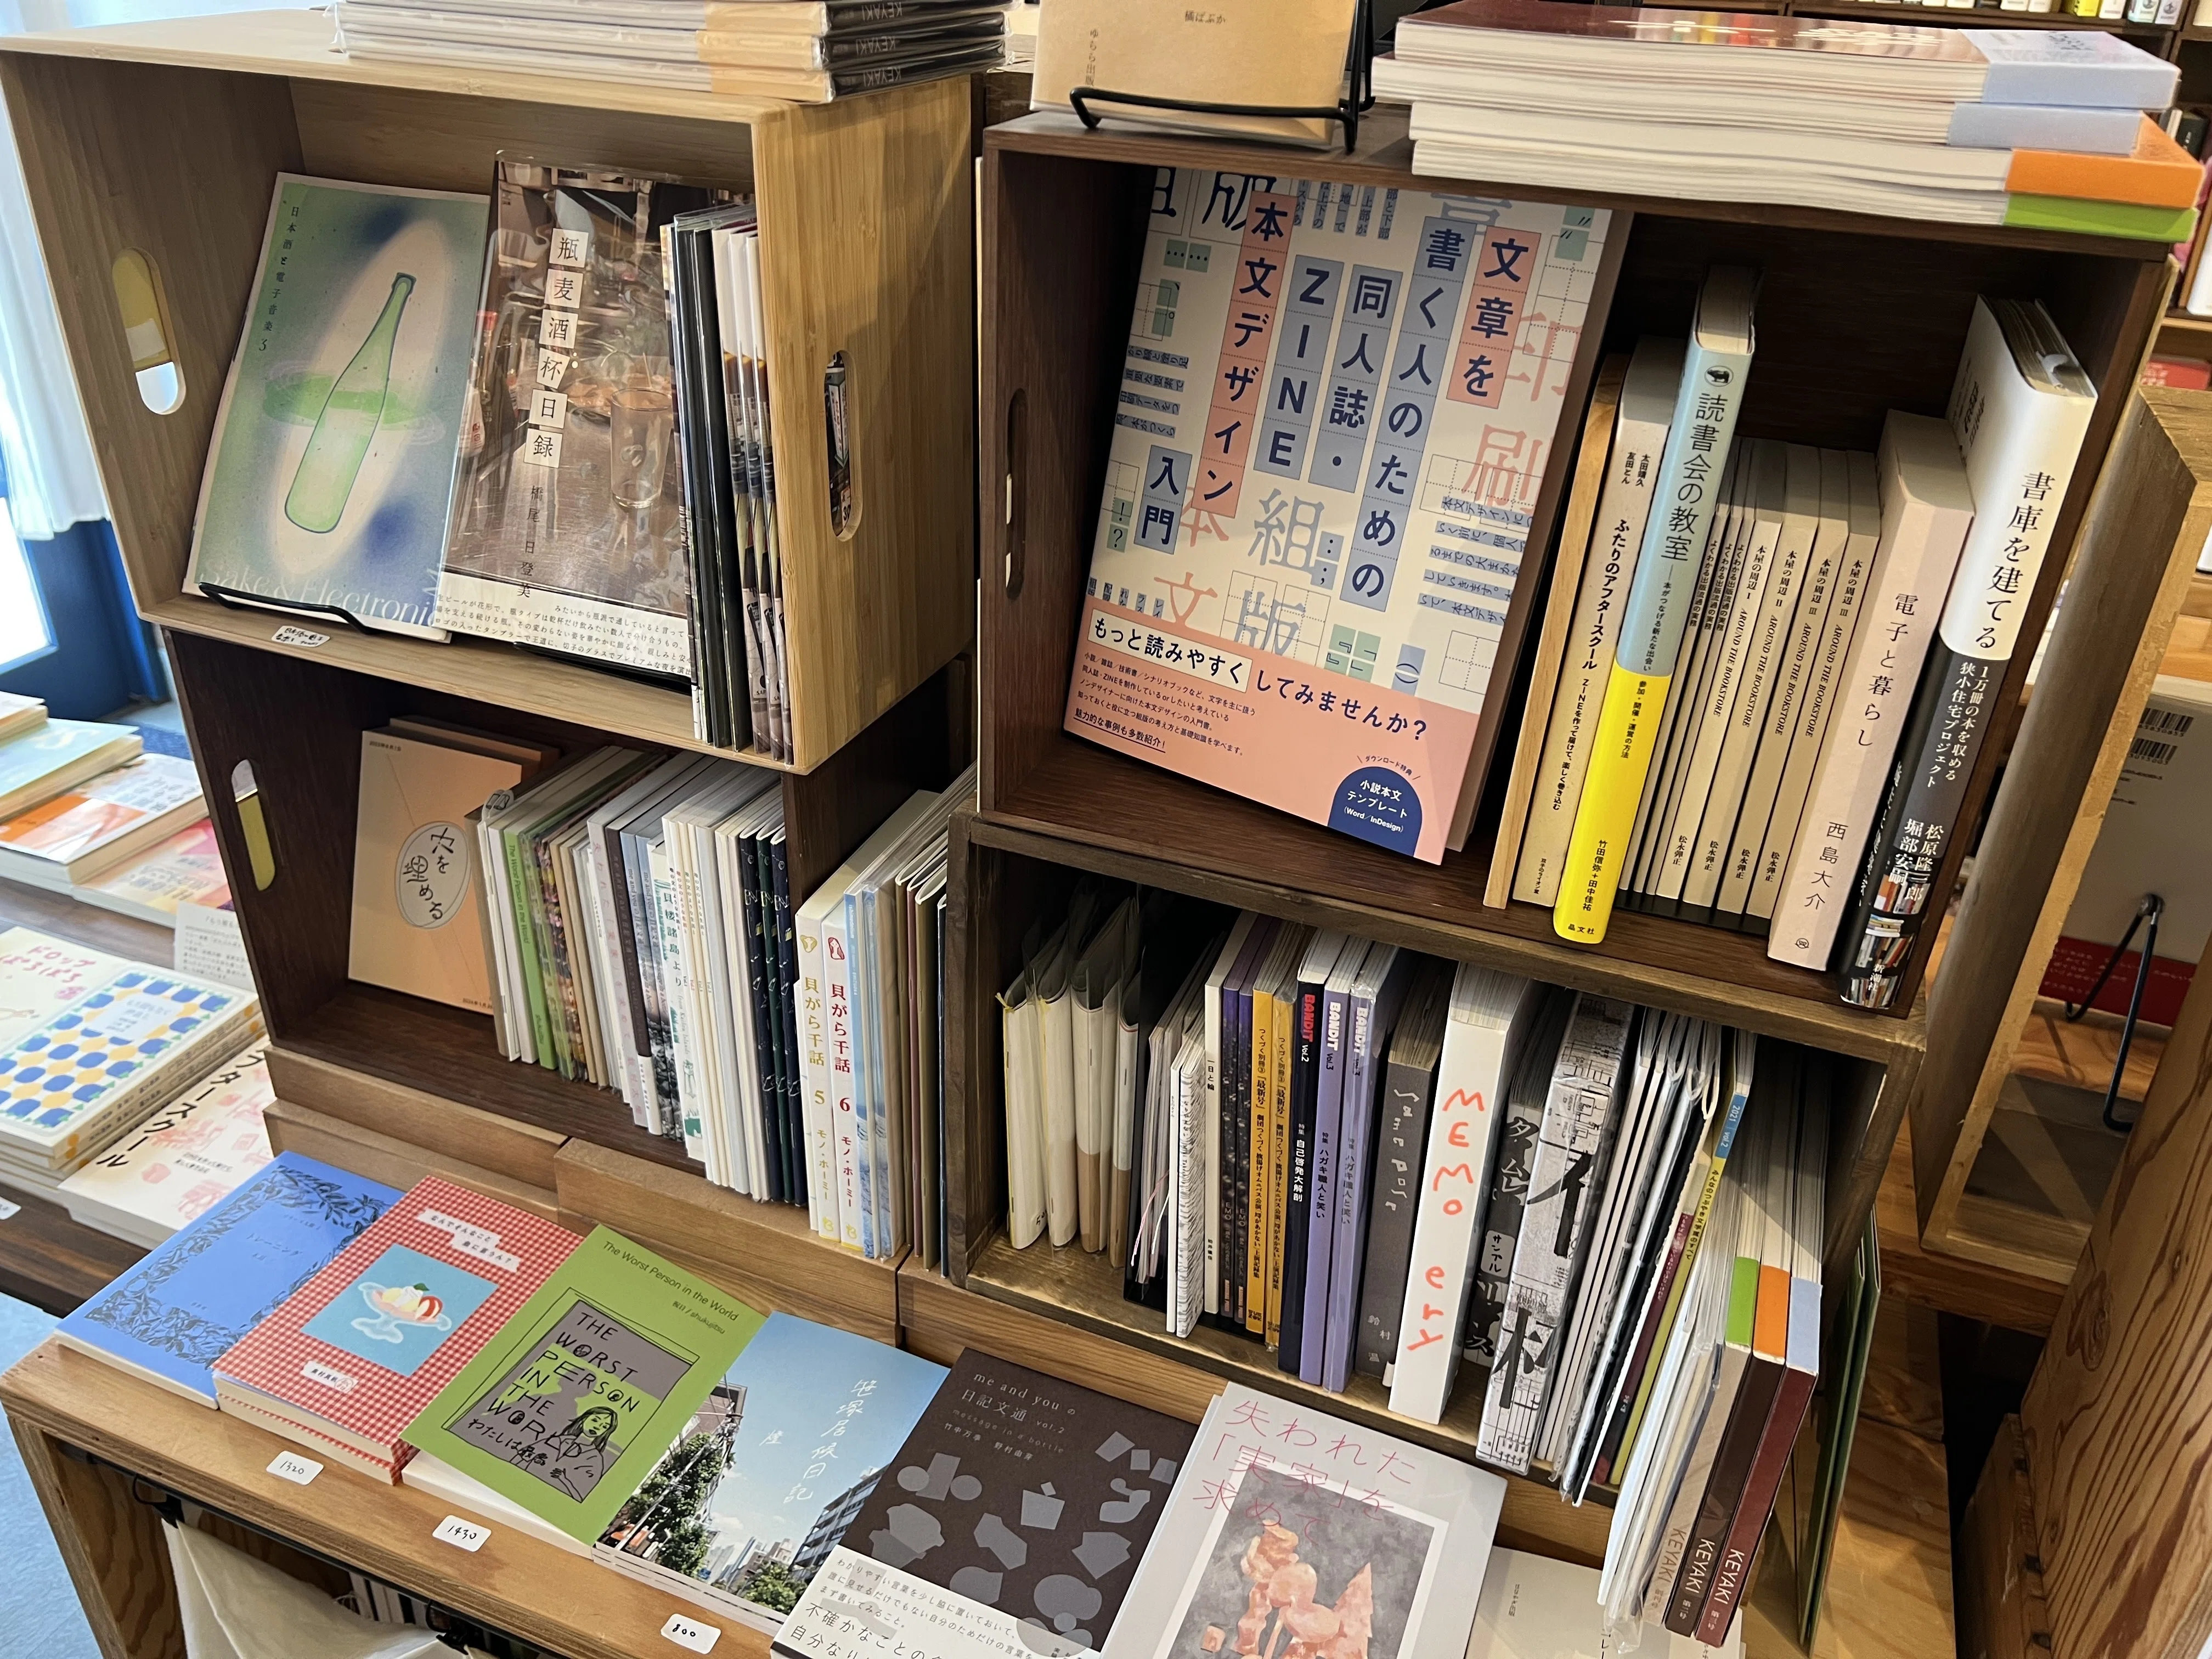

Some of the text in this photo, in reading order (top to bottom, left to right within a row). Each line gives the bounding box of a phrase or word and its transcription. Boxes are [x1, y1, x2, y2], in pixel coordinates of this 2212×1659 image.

[856, 36, 896, 51] KEYAKI
[862, 2, 902, 21] KEYAKI
[864, 66, 901, 87] KEYAKI
[532, 235, 580, 458] 瓶麦酒杯日録
[1204, 202, 1288, 500] 本文デザイン
[1463, 237, 1528, 399] 文章を
[1269, 268, 1329, 466] ZINE
[1352, 228, 1465, 597] 書く人のための
[1142, 456, 1179, 545] 入門
[1643, 393, 1727, 671] 読書会の教室 本がつなげる新たな出会い
[1582, 519, 1630, 670] ふたりのアフタースクール
[1689, 540, 1718, 627] よくわかる出版流通の実務
[1704, 543, 1733, 630] よくわかる出版流通の実務
[1717, 545, 1745, 631] よくわかる出版流通の実務
[1975, 471, 2055, 650] 書庫を建てる
[1713, 545, 1767, 718] 本屋の周辺 AROUND THE BOOKSTORE
[1742, 550, 1797, 728] 本屋の周辺 AROUND THE BOOKSTORE
[1775, 558, 1832, 736] 本屋の周辺 AROUND THE BOOKSTORE
[1805, 560, 1863, 738] 本屋の周辺 AROUND THE BOOKSTORE
[1095, 618, 1427, 740] もっと読みやすく してみませんか？
[1858, 593, 1919, 747] 電子と暮らし
[1927, 662, 1976, 788] 狭小住宅プロジェクト
[1945, 665, 1990, 781] 1万冊の本を収める
[1360, 780, 1402, 802] 小説本文
[1365, 755, 1413, 776] ダウンロード特典
[1348, 791, 1407, 818] テンプレート
[1804, 821, 1849, 911] 西島大介
[1888, 819, 1924, 884] 堀部安嗣
[1904, 823, 1944, 901] 松原隆一郎
[1567, 924, 1595, 935] 晶文社
[804, 977, 825, 1067] 貝がら千話
[815, 1090, 825, 1105] 5
[1302, 994, 1316, 1043] BANDIT
[1328, 1001, 1341, 1052] BANDIT
[1355, 1006, 1369, 1056] BANDIT
[831, 984, 854, 1208] 貝がら千話 6 モノ・ホーミー
[1729, 1104, 1741, 1122] 2021
[1293, 1138, 1306, 1203] 自己啓発大解剖
[1316, 1149, 1329, 1218] ハガキ職人と笑い
[1434, 1087, 1485, 1216] MEMO
[603, 1240, 740, 1321] The Worst Person in the World
[555, 1331, 639, 1382] WORST
[574, 1311, 619, 1341] THE
[507, 1383, 555, 1417] THE
[520, 1367, 550, 1389] IN
[535, 1350, 642, 1414] PERSON
[961, 1388, 1066, 1435] 日記文通 vol.2
[974, 1372, 995, 1387] me
[1000, 1381, 1029, 1400] and
[1032, 1394, 1060, 1411] you
[486, 1398, 583, 1458] WORLD
[952, 1408, 998, 1431] message
[1003, 1427, 1013, 1436] in
[1028, 1435, 1064, 1454] bottle
[1225, 1400, 1416, 1485] 失われた
[279, 1459, 305, 1476] 1320
[1212, 1432, 1394, 1522] 「実家」を
[1193, 1479, 1331, 1546] 求めて
[1660, 1528, 1687, 1584] KEYAKI
[1685, 1538, 1716, 1594] KEYAKI
[1714, 1548, 1745, 1605] KEYAKI
[819, 1585, 906, 1629] まず書いてみること。
